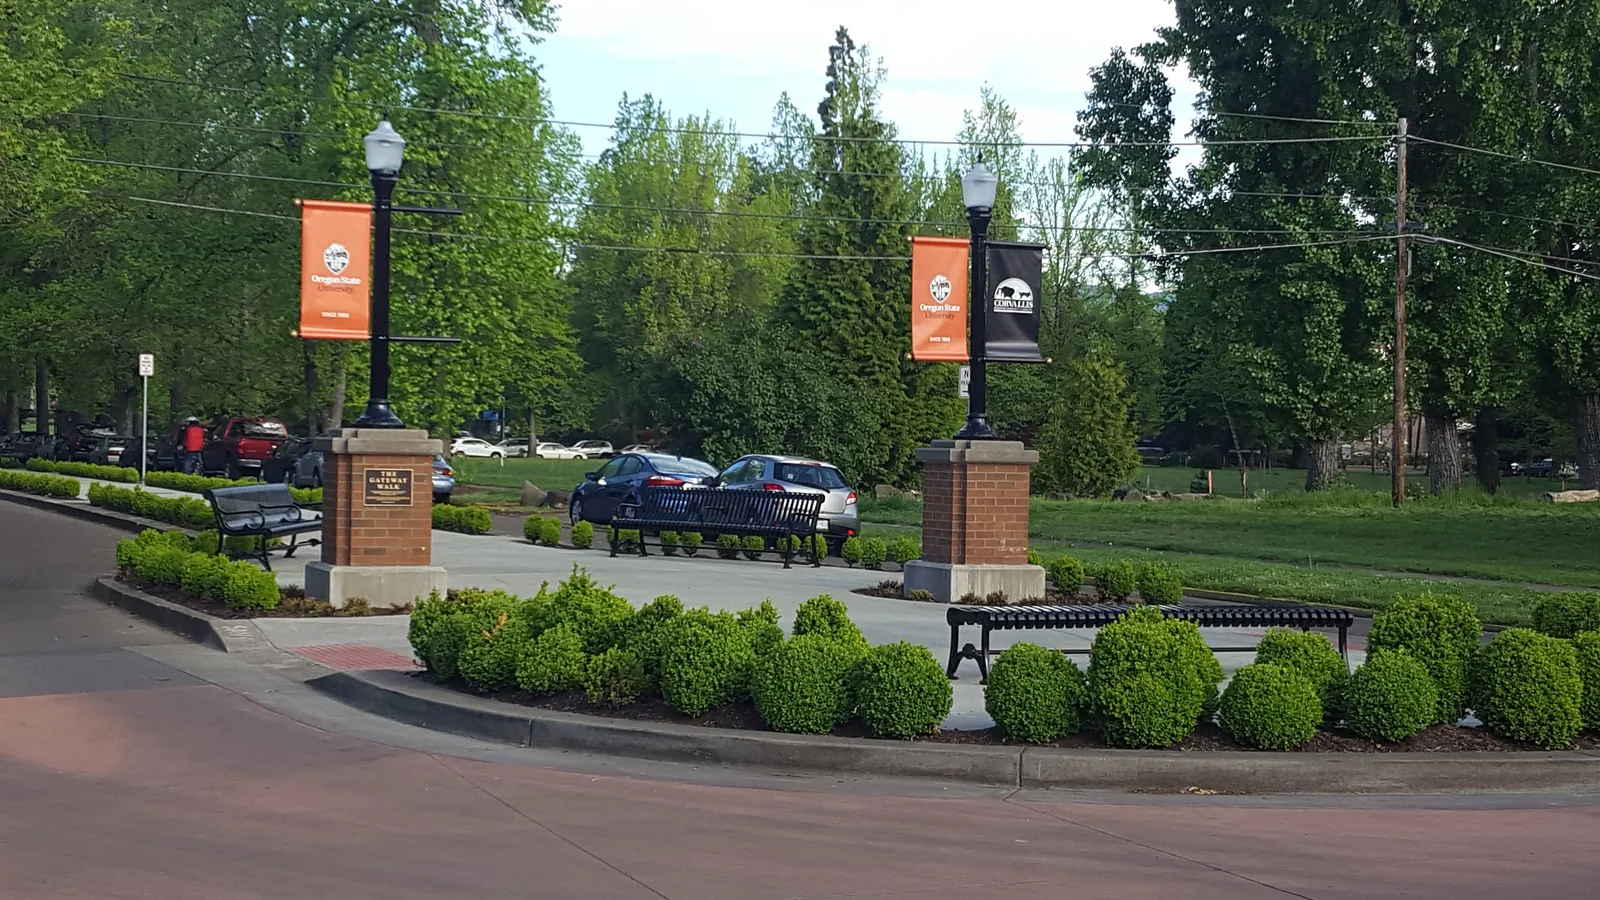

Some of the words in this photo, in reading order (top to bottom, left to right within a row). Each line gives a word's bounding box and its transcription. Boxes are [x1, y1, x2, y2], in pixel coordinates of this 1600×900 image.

[311, 274, 339, 285] Oregon
[339, 276, 362, 285] State
[318, 283, 354, 295] University
[919, 303, 944, 313] Oregon
[944, 304, 961, 312] State
[993, 299, 1034, 309] CORVALLIS
[925, 312, 956, 320] University
